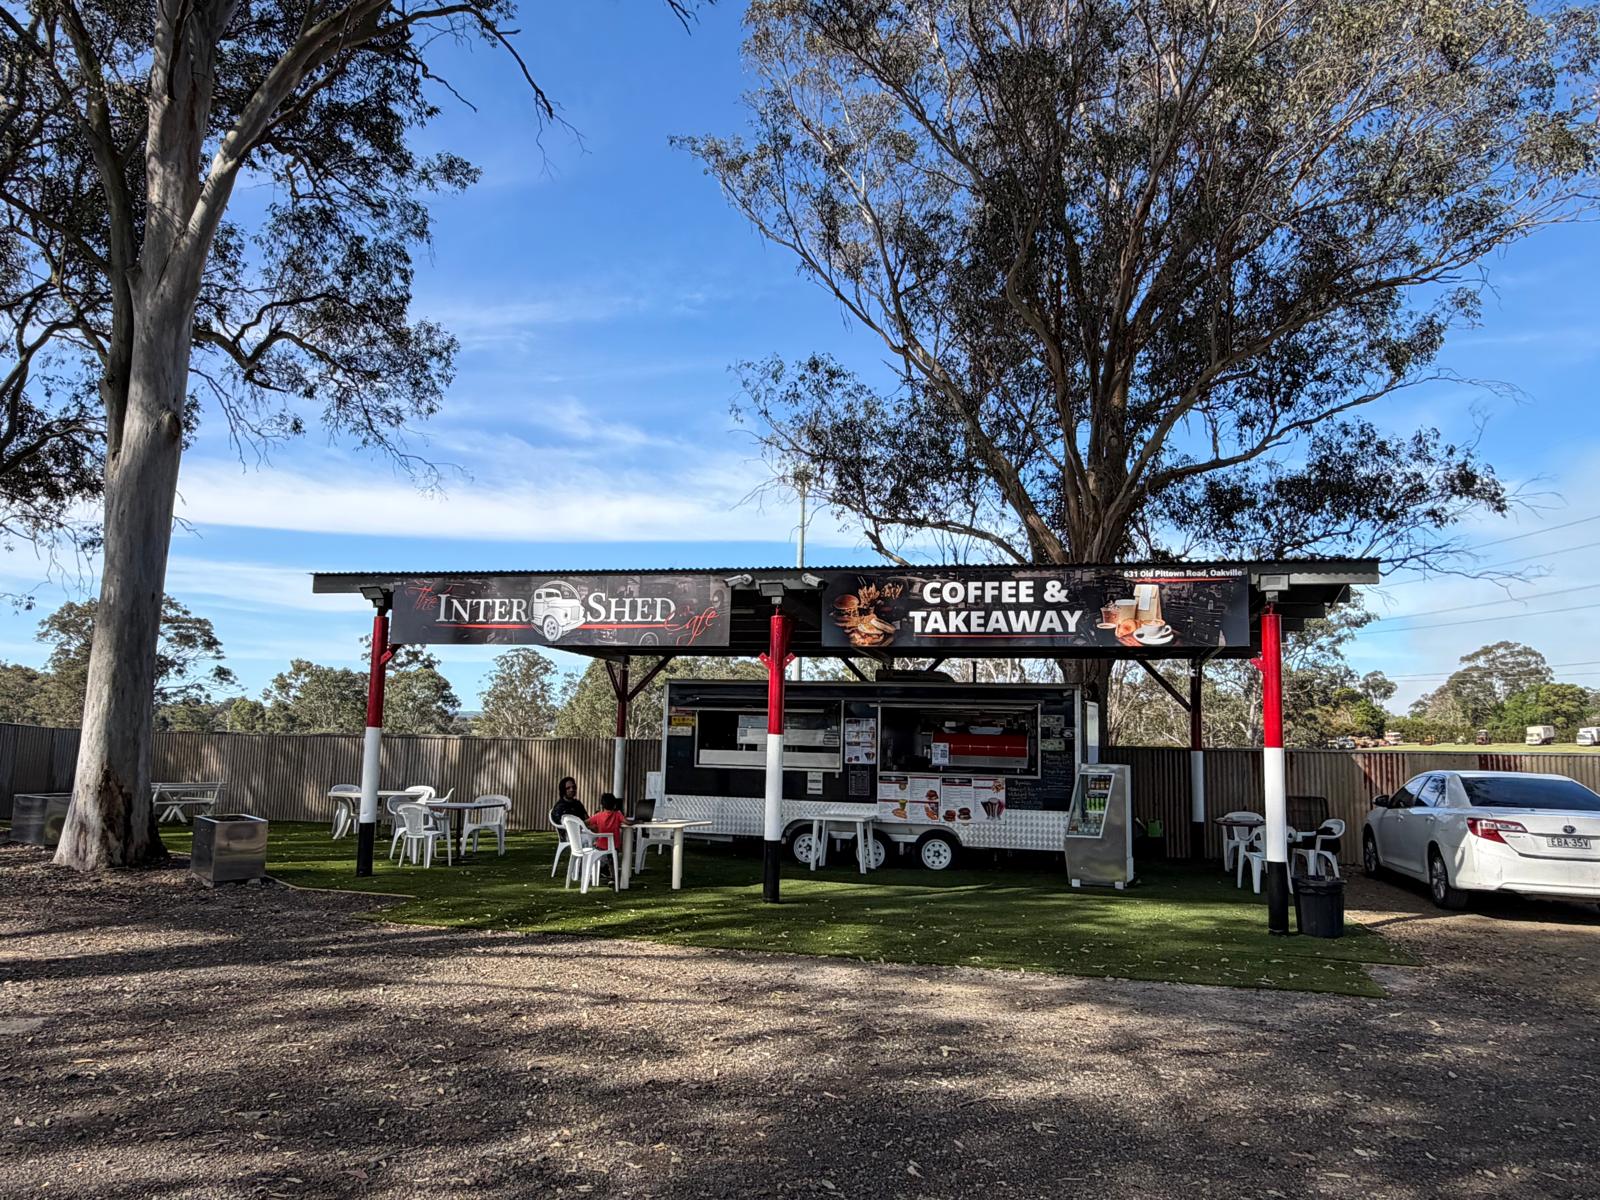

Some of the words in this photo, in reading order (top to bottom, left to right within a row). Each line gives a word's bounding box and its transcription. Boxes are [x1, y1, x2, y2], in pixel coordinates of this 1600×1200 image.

[1140, 569, 1153, 577] Old
[1186, 569, 1209, 578] Road,
[405, 583, 438, 611] The
[922, 580, 1034, 605] COFFEE
[1043, 579, 1069, 604] &
[435, 593, 528, 622] INTER
[586, 592, 676, 622] SHED
[909, 609, 1083, 634] TAKEAWAY
